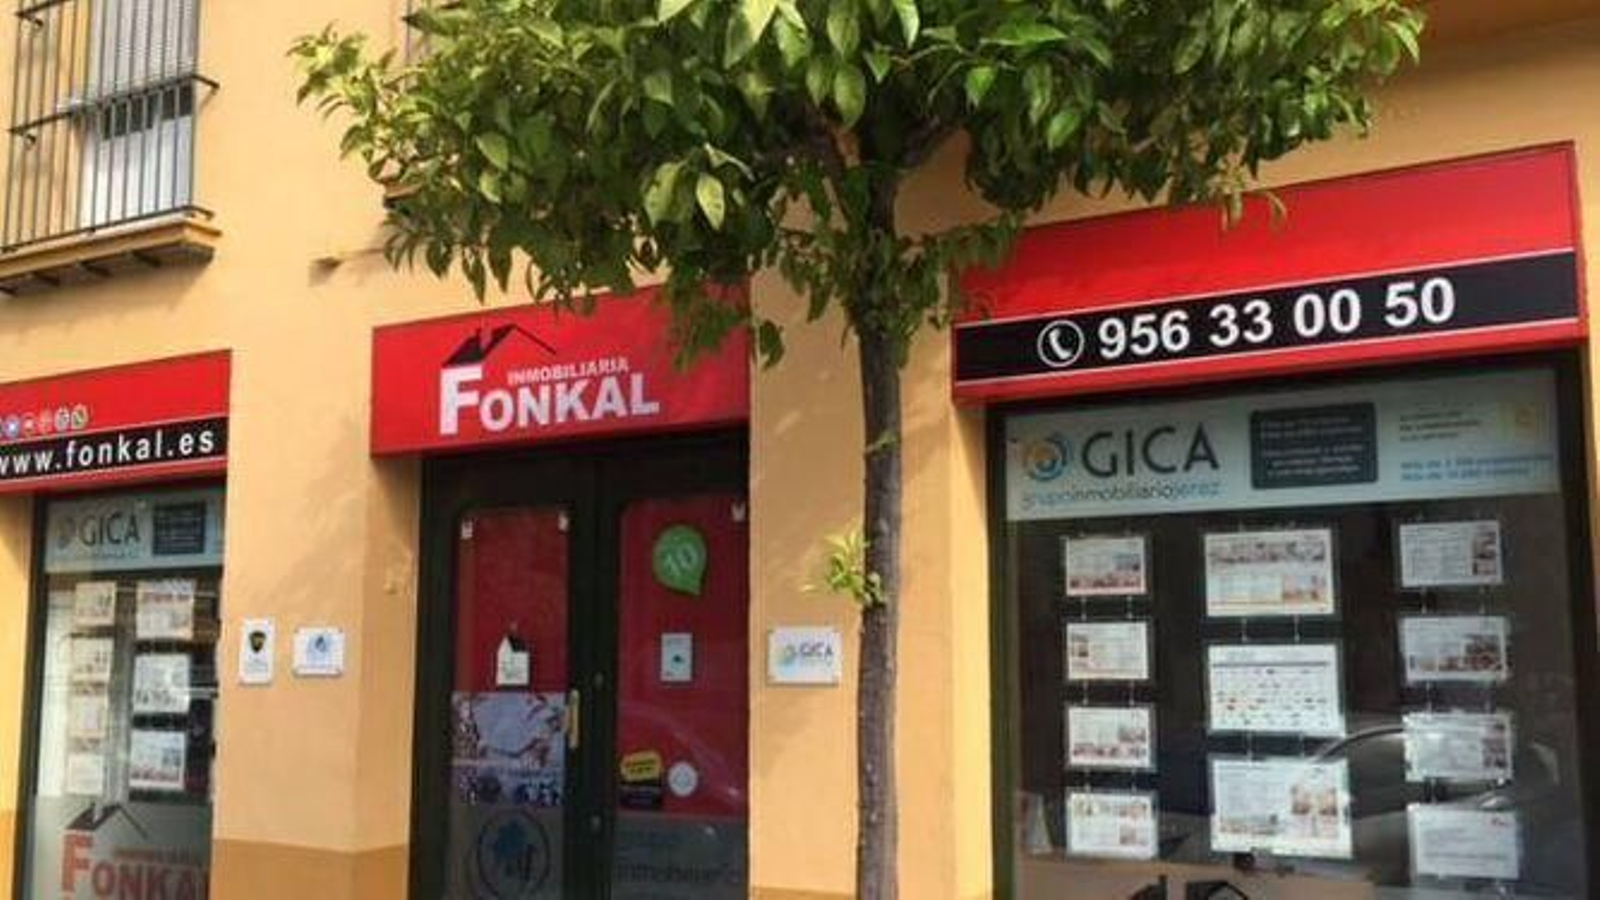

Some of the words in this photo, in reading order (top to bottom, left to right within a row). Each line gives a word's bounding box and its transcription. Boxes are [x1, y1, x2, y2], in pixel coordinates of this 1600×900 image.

[1099, 308, 1190, 359] 956
[1208, 299, 1274, 348] 33
[1292, 288, 1361, 338] 00
[1384, 276, 1456, 328] 50
[440, 364, 661, 434] FONKAL
[507, 356, 630, 386] INMOBILIARIA
[1080, 419, 1221, 478] GICA
[78, 509, 142, 548] GICA
